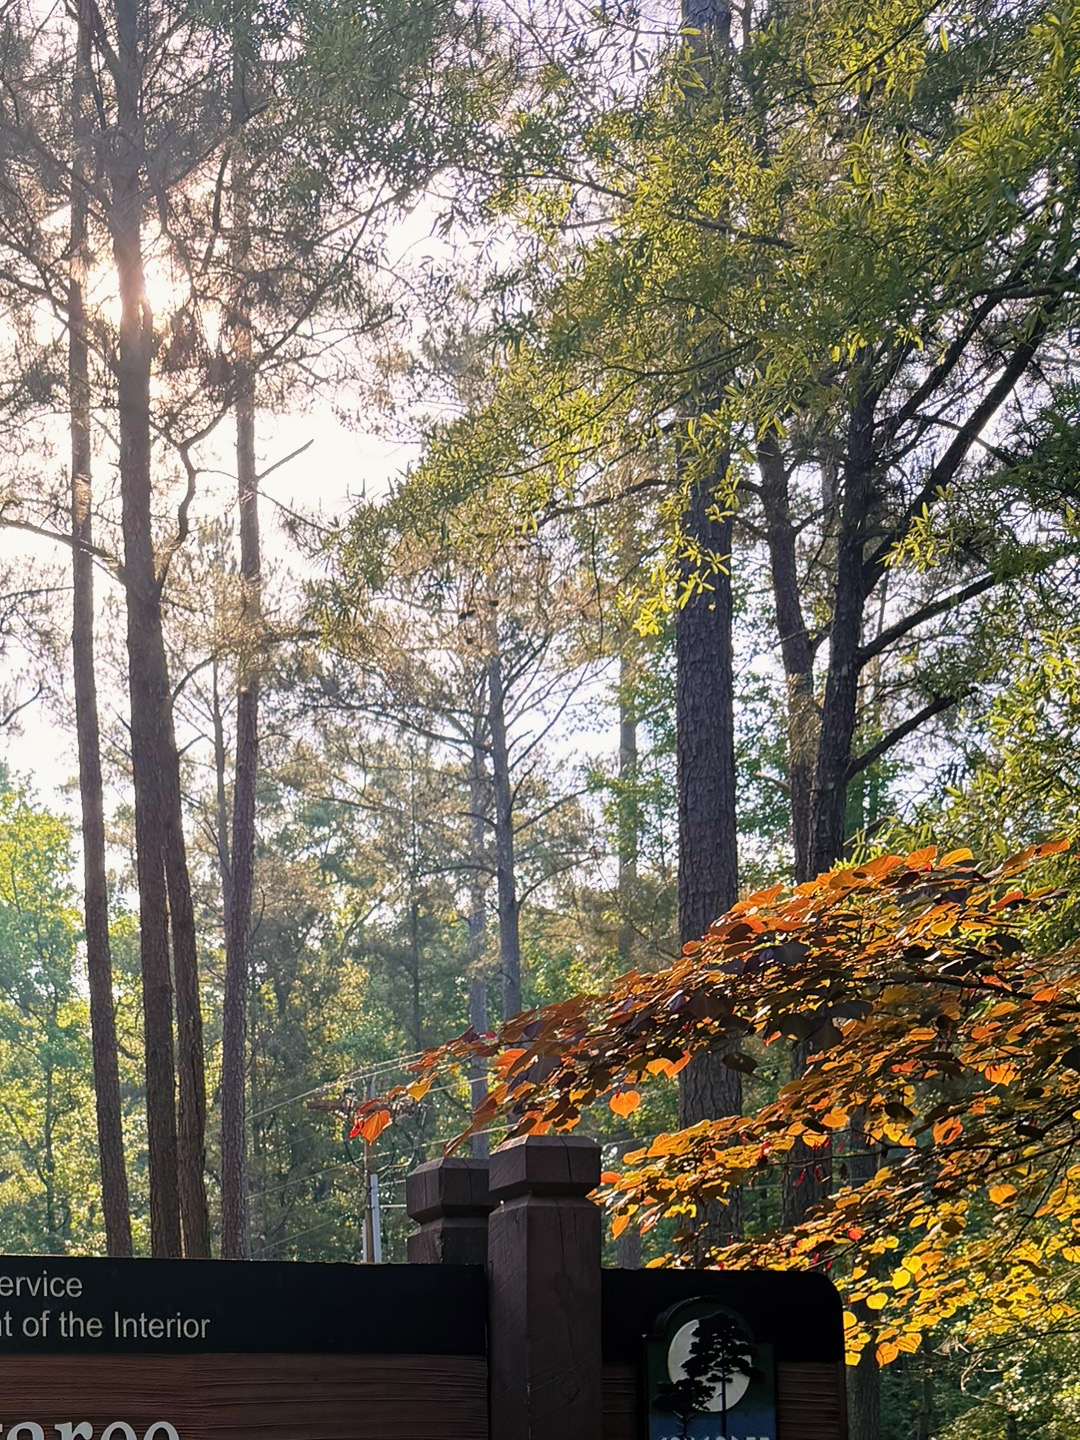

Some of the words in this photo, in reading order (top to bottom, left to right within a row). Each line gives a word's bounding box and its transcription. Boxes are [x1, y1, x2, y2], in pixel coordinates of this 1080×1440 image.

[22, 1310, 50, 1338] of
[59, 1310, 103, 1339] the
[115, 1312, 210, 1339] Interior
